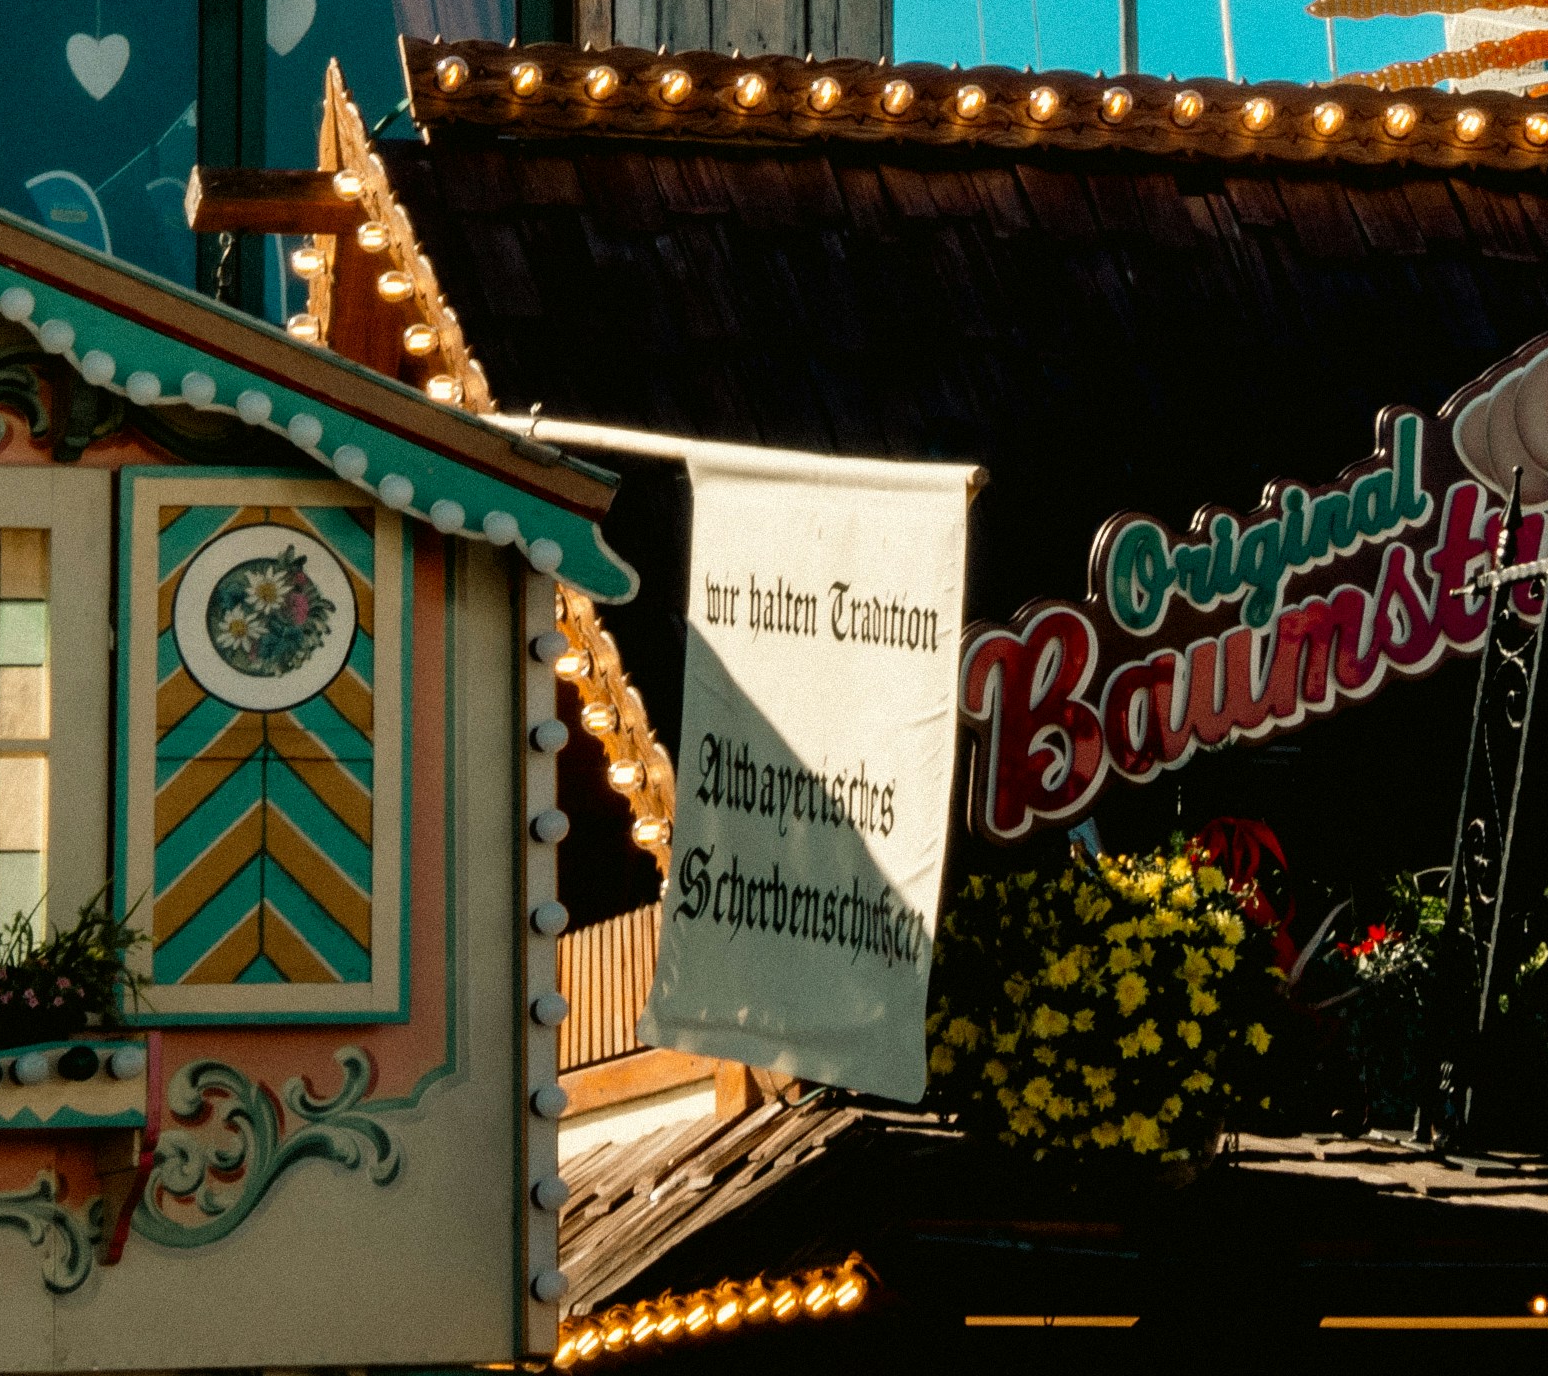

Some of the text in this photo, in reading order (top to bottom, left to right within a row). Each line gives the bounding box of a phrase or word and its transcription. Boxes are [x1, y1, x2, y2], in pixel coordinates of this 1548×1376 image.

[1106, 412, 1435, 637] Original
[704, 570, 939, 654] wir halten Tradition
[695, 732, 897, 842] Altbayerisches
